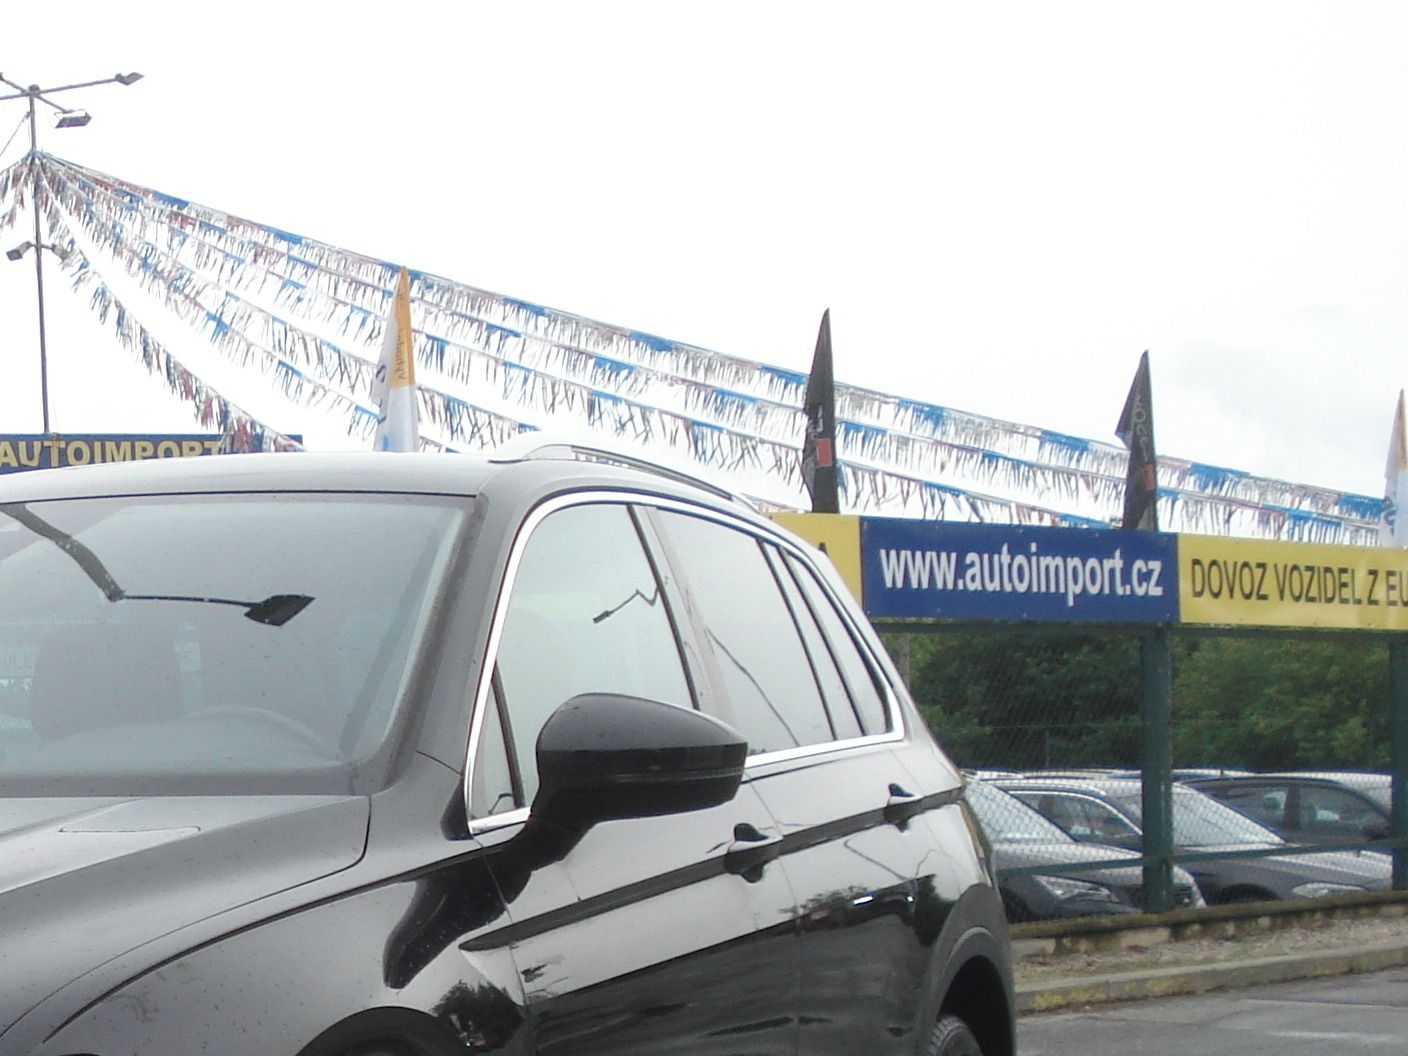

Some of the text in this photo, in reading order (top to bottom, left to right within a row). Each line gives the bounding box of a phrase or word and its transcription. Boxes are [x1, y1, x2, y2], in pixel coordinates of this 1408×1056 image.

[879, 542, 1163, 607] www.autoimport.cz
[1192, 558, 1269, 601] DOVOZ
[1274, 562, 1362, 605] VOZIDEL
[1367, 568, 1380, 606] Z
